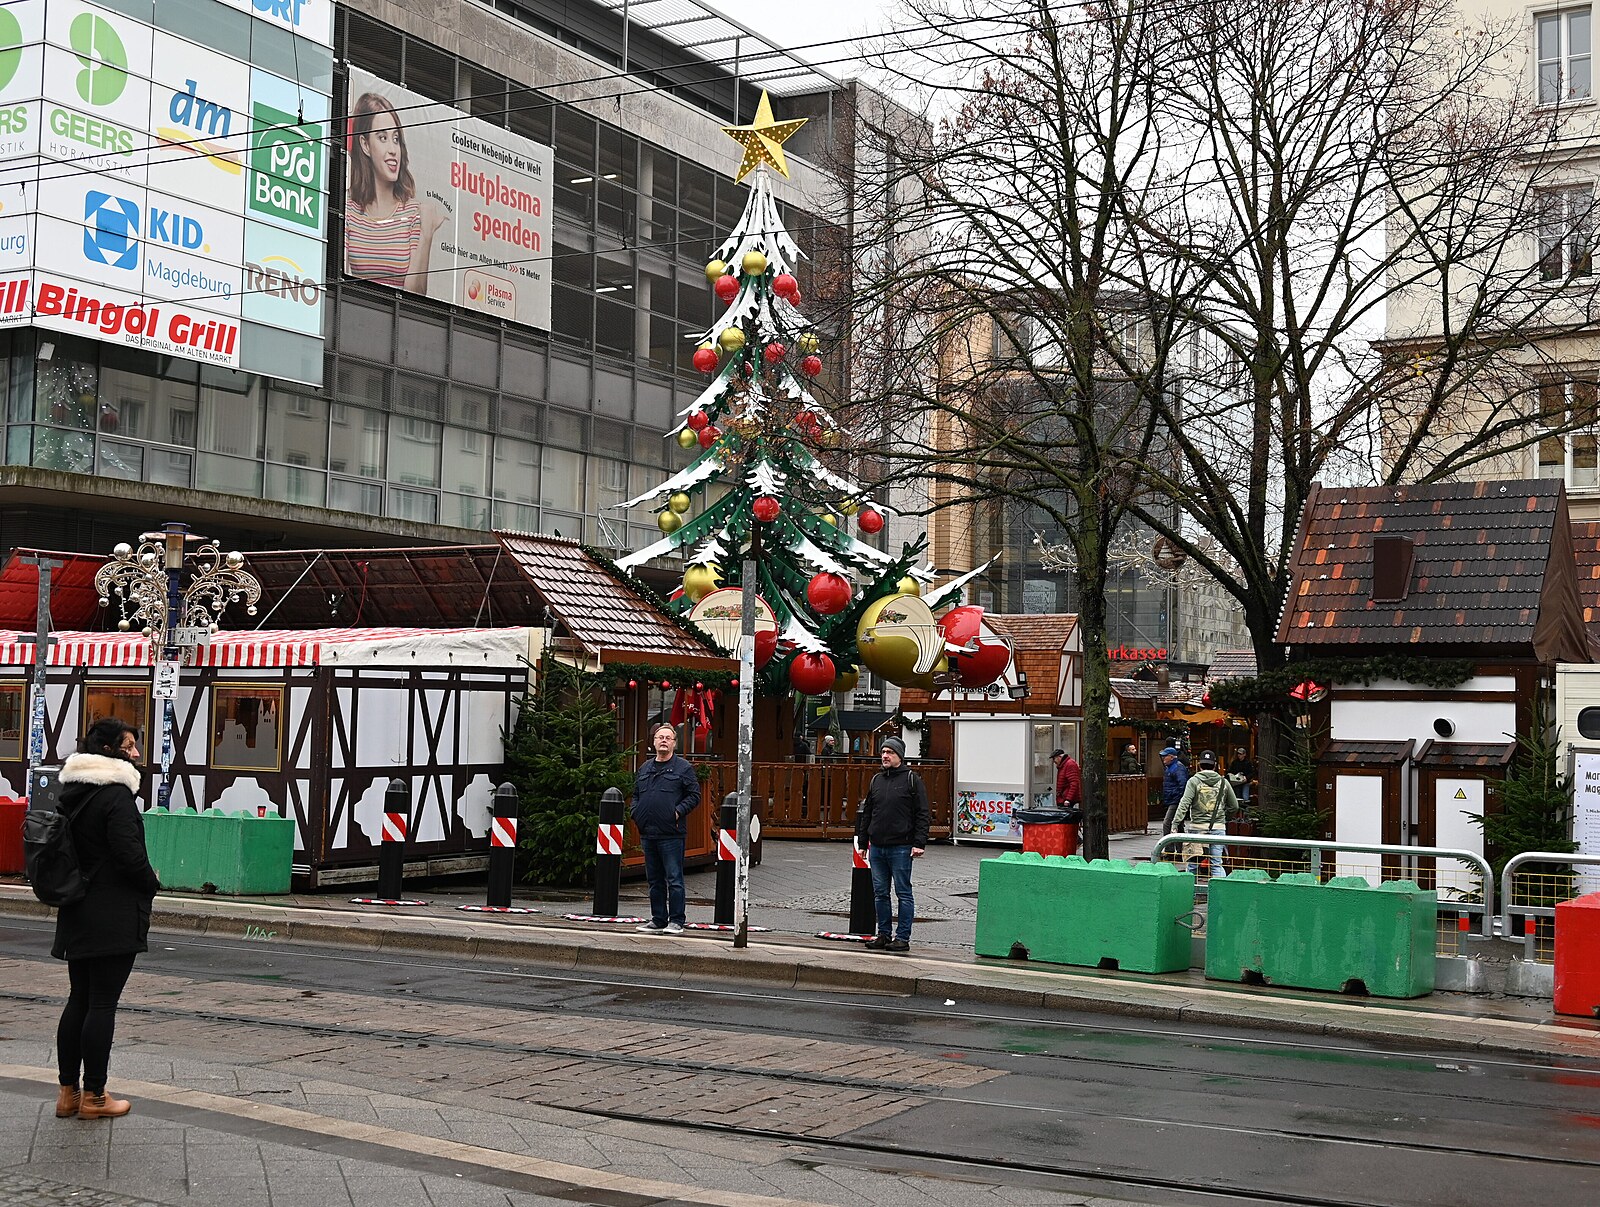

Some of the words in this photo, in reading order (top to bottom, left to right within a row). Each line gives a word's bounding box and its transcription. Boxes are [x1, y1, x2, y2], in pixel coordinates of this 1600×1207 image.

[169, 79, 231, 140] dm
[50, 108, 133, 156] GEERS
[50, 142, 132, 176] HÖRAKUSTIK
[270, 140, 315, 184] psd
[452, 132, 480, 152] Coolster
[481, 143, 513, 165] Nebenjob
[514, 155, 526, 170] der
[527, 161, 541, 176] Welt
[255, 172, 314, 218] Bank
[451, 161, 541, 217] Blutplasma
[473, 211, 541, 252] spenden
[148, 258, 231, 300] Magdeburg
[440, 242, 457, 254] Gleich
[457, 246, 469, 258] hier
[469, 252, 478, 261] am
[479, 254, 493, 265] Alten
[519, 267, 525, 276] 15
[526, 270, 541, 281] Meter
[245, 261, 319, 306] RENO
[487, 284, 513, 301] Plasma
[487, 296, 506, 309] Service
[36, 283, 160, 337] Bingöl
[168, 313, 237, 355] Grill
[125, 333, 139, 344] DAS
[140, 337, 172, 351] ORIGINAL
[174, 345, 185, 354] AM
[187, 347, 208, 359] ALTEN
[209, 353, 232, 364] MARKT
[970, 800, 1012, 814] KASSE
